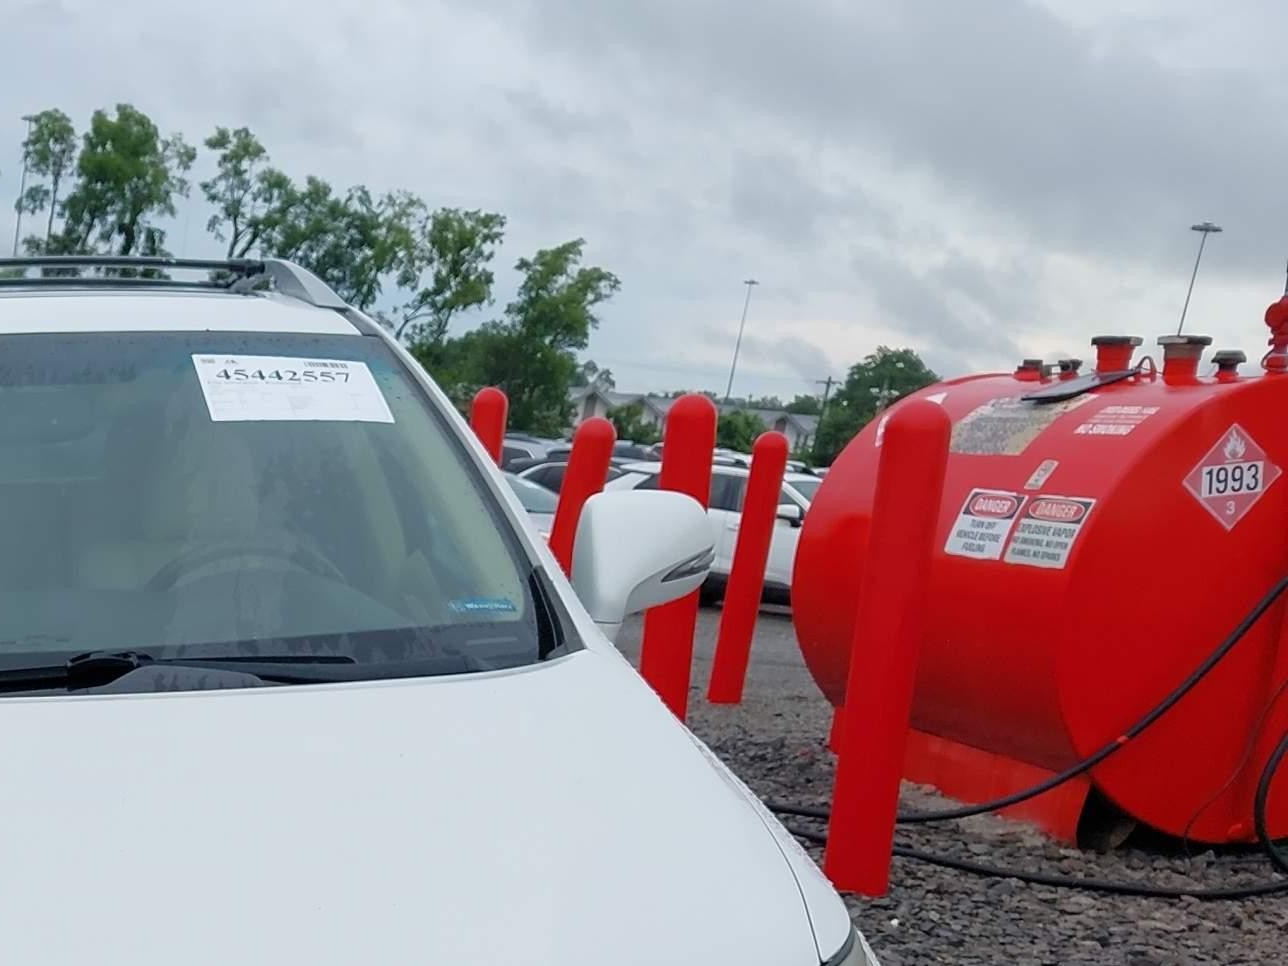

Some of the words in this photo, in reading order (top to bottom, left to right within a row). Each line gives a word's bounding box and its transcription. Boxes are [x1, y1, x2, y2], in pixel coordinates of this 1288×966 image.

[215, 368, 350, 383] 45442557
[1205, 463, 1259, 496] 1993
[974, 497, 1011, 514] DANGER
[1034, 501, 1079, 518] DANGER
[1225, 500, 1236, 515] 3
[970, 518, 985, 529] TURN
[1016, 522, 1052, 537] EXPLOSIVE
[1052, 526, 1076, 539] VAPOR
[956, 528, 980, 541] VEHICLE
[978, 531, 1002, 543] BEFORE
